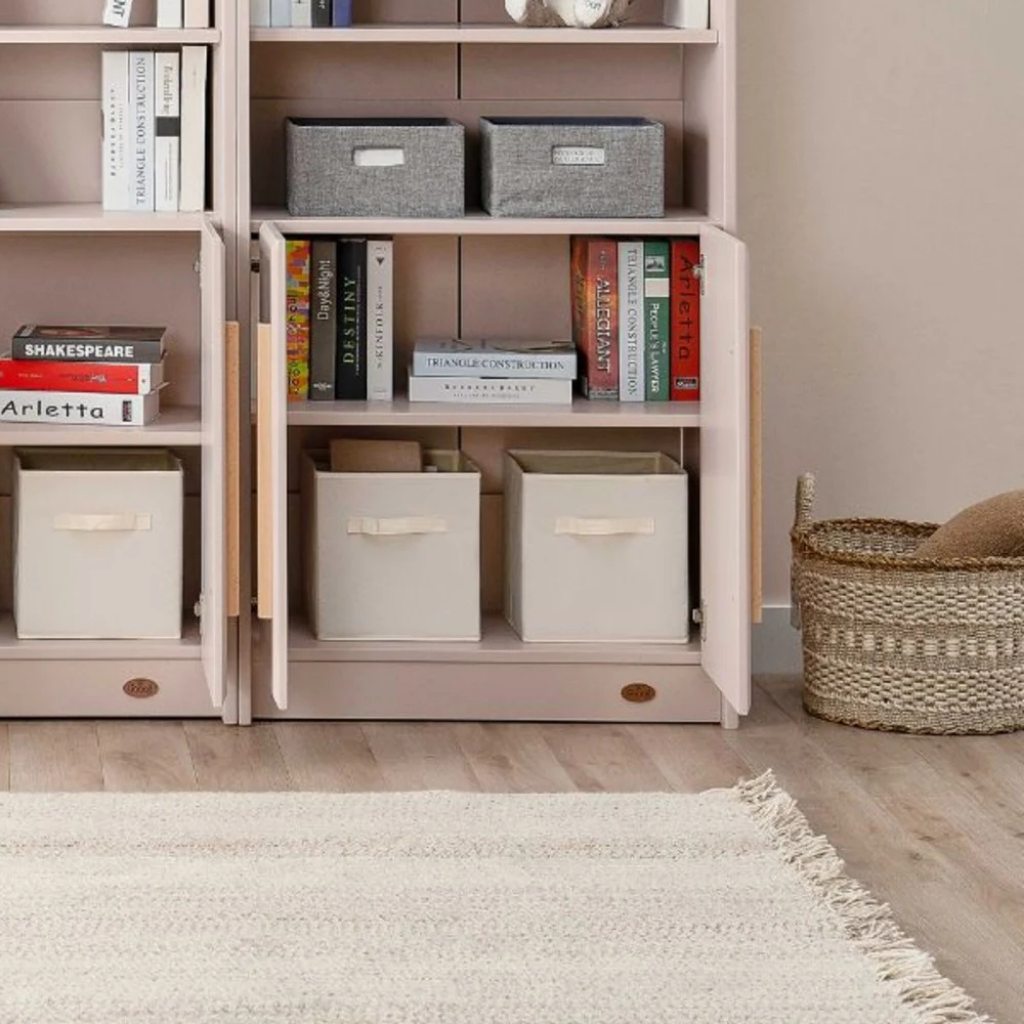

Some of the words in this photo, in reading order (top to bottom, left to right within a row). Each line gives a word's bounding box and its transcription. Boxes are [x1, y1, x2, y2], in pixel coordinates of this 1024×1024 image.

[136, 57, 146, 147] CONSTRUCTION
[136, 148, 146, 205] TRIANGLE
[627, 248, 638, 305] TRIANGLE
[679, 255, 696, 359] Arletta
[25, 344, 134, 358] SHAKESPEARE
[343, 276, 356, 363] DESTINY
[595, 277, 612, 373] ALLEGIANT
[627, 308, 638, 395] CONSTRUCTION
[427, 358, 479, 367] TRIANGLE
[480, 359, 565, 370] CONSTRUCTION
[1, 400, 104, 419] Arletta
